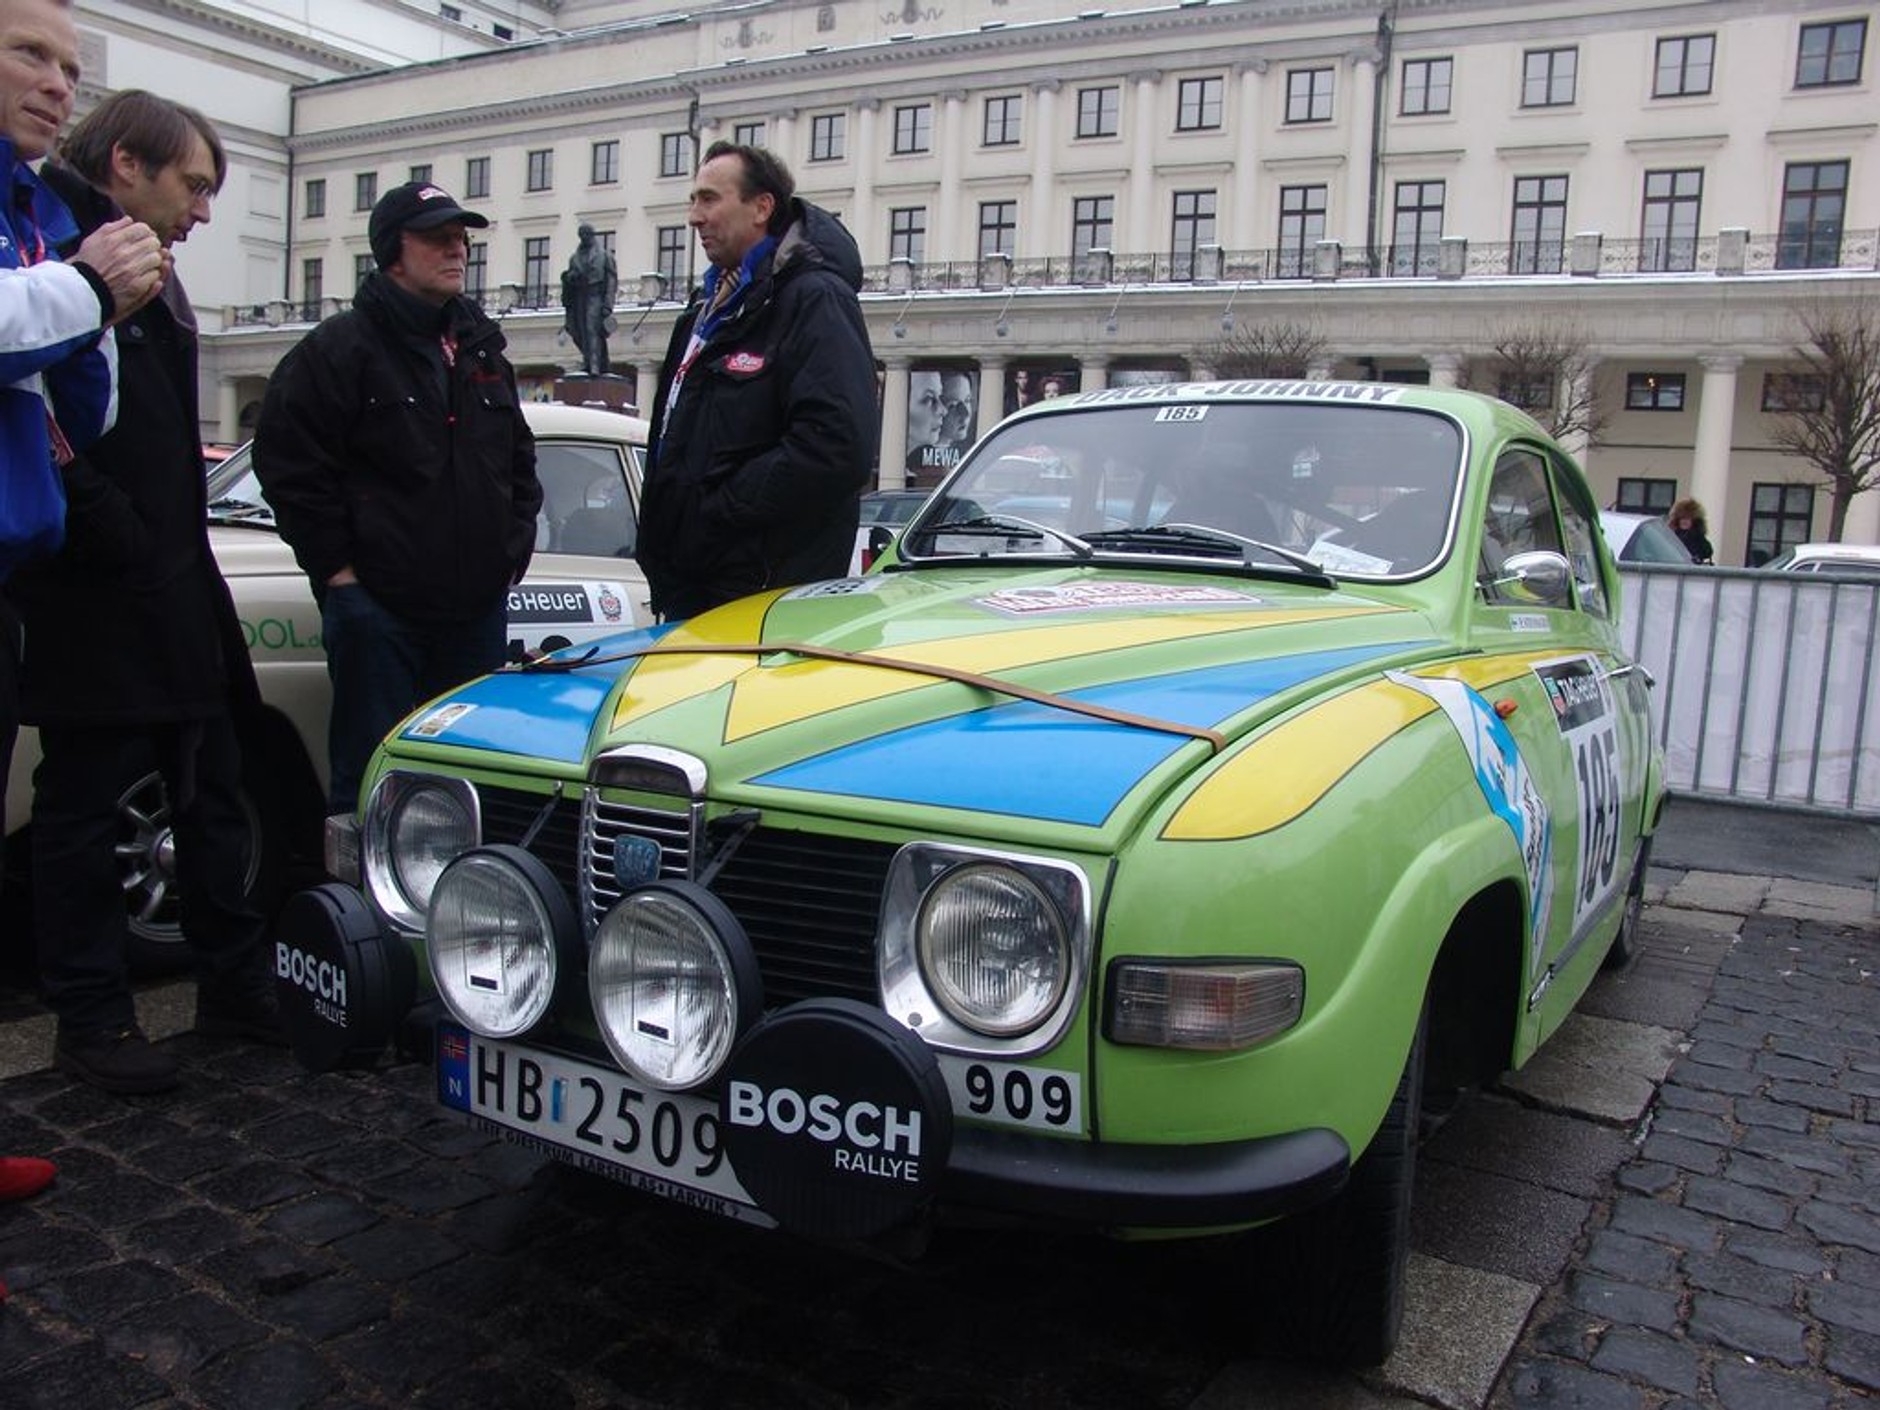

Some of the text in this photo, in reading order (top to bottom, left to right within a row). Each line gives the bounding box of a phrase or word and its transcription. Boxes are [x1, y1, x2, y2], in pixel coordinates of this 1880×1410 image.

[1163, 406, 1200, 420] 185
[921, 447, 960, 467] MEWA
[506, 591, 585, 611] GHeuer
[1576, 727, 1620, 914] 185
[276, 941, 347, 1007] BOSCH
[314, 998, 347, 1028] RALLYE
[447, 1077, 463, 1098] N
[965, 1063, 1072, 1125] 909
[476, 1045, 724, 1178] HB 2509
[729, 1080, 922, 1156] BOSCH
[835, 1149, 919, 1183] RALLYE
